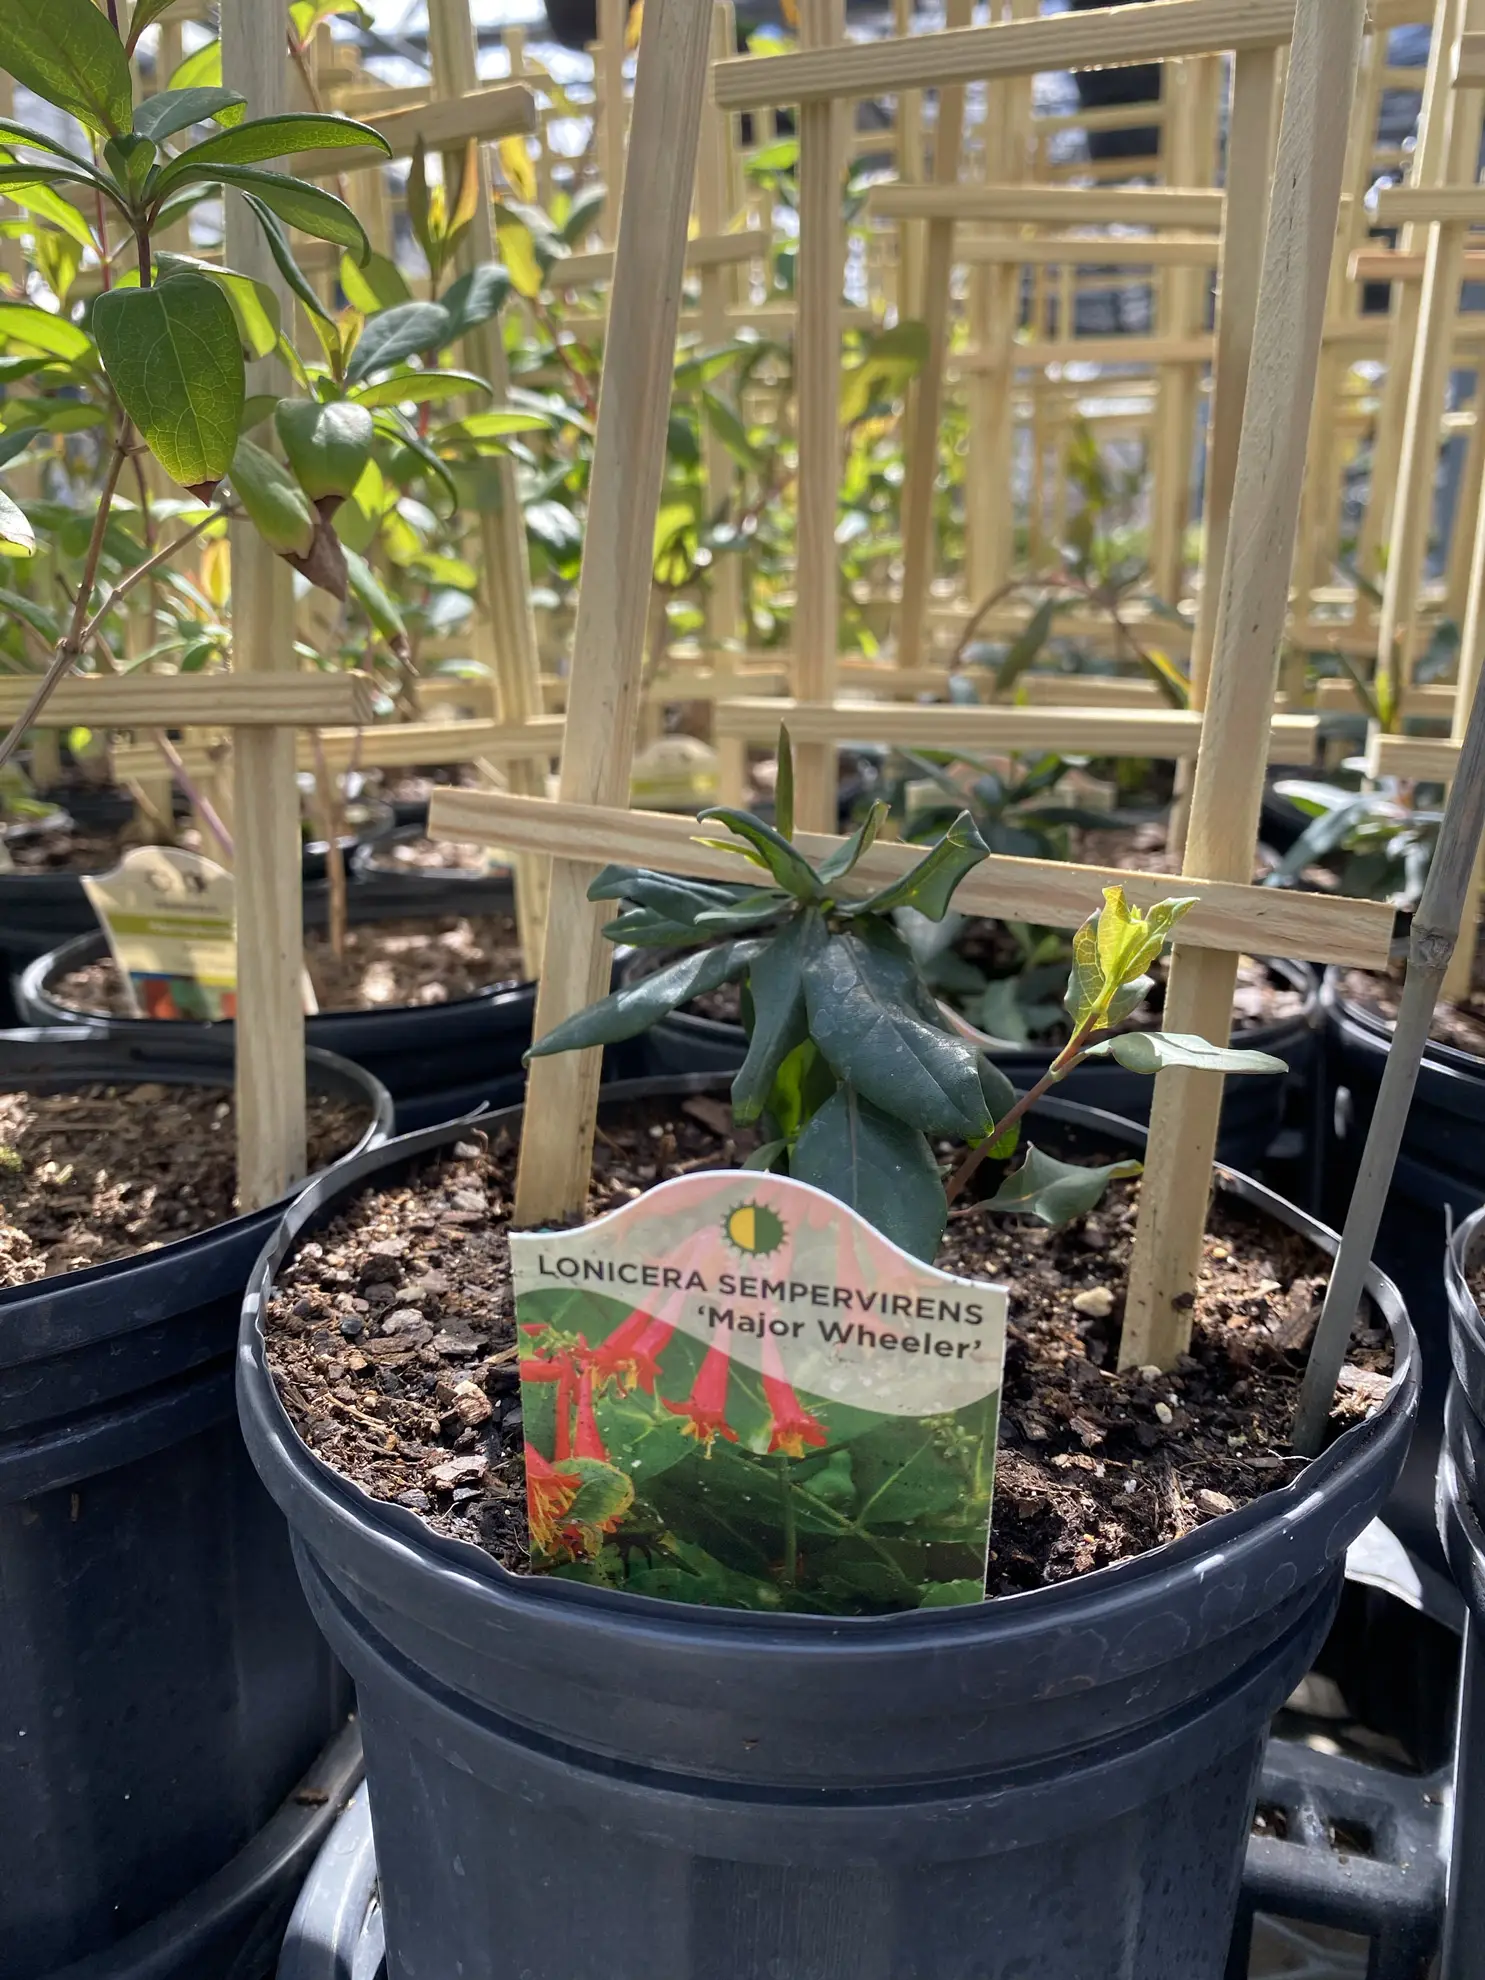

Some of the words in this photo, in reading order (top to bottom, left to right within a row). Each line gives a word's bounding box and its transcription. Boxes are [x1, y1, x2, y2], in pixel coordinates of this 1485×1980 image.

[538, 1254, 708, 1292] LONICERA
[718, 1274, 985, 1326] SEMPERVIRENS
[697, 1304, 805, 1339] ‘Major
[817, 1319, 982, 1359] Wheeler’
